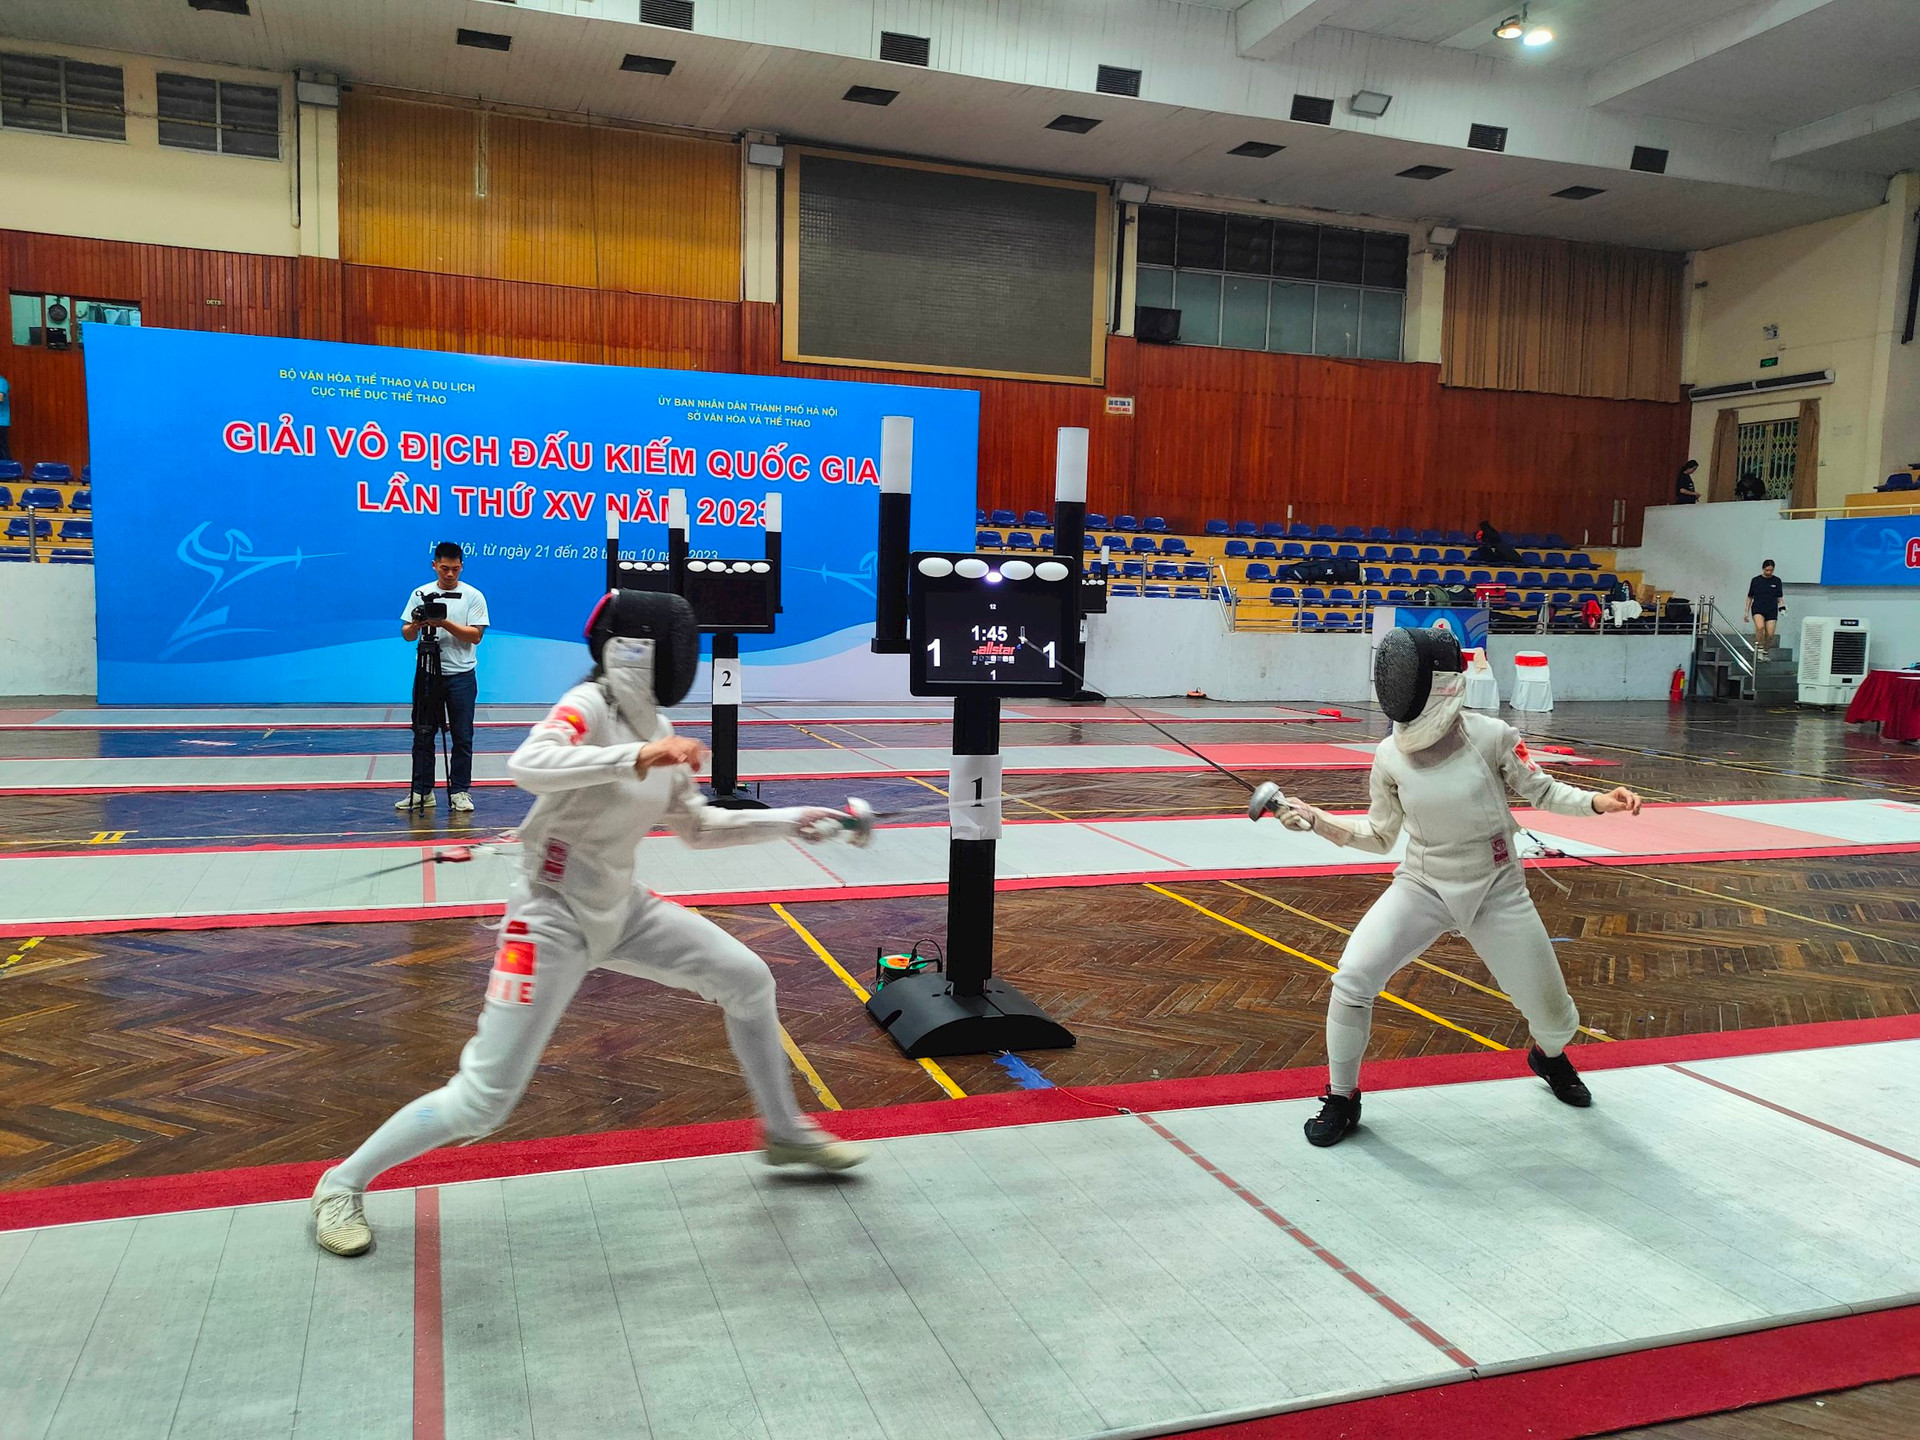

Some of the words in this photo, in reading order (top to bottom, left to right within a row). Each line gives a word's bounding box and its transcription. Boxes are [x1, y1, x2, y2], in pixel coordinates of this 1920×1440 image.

[279, 368, 297, 381] BỘ
[299, 369, 324, 382] VĂN
[327, 371, 351, 383] HÓA
[355, 372, 377, 385] THỂ
[380, 377, 412, 388] THAO
[414, 377, 429, 389] VÀ
[432, 380, 448, 390] DU
[451, 382, 475, 394] LỊCH
[311, 386, 336, 397] CỤC
[339, 385, 361, 398] THỂ
[364, 389, 388, 401] DỤC
[391, 389, 413, 402] THỂ
[416, 393, 447, 405] THAO
[658, 395, 672, 406] ỦY
[674, 398, 695, 408] BAN
[697, 398, 725, 409] NHÂN
[727, 399, 747, 411] DÂN
[749, 401, 782, 413] THÀNH
[784, 403, 804, 415] PHỐ
[806, 405, 820, 415] HÀ
[822, 406, 838, 419] NỘI
[687, 410, 701, 421] SỞ
[703, 411, 723, 422] VĂN
[726, 412, 746, 424] HÓA
[748, 414, 762, 425] VÀ
[764, 415, 782, 426] THỂ
[785, 417, 811, 428] THAO
[223, 413, 316, 456] GIẢI
[326, 421, 388, 460] VÔ
[399, 430, 499, 470] ĐỊCH
[510, 431, 593, 471] ĐẤU
[605, 436, 696, 476] KIẾM
[706, 442, 810, 480] QUỐC
[819, 455, 880, 486] GIA
[357, 472, 440, 515] LẦN
[451, 482, 536, 518] THỨ
[544, 491, 595, 521] XV
[460, 541, 478, 558] ội,
[483, 542, 497, 556] từ
[499, 544, 531, 560] ngày
[535, 544, 550, 558] 21
[554, 544, 579, 559] đến
[582, 546, 598, 559] 28
[601, 547, 636, 560] tng
[641, 548, 656, 561] 10
[688, 549, 719, 560] 2023
[1905, 537, 1920, 569] G
[971, 625, 1008, 642] 1:45
[927, 638, 941, 667] 1
[975, 641, 1015, 655] allstar
[1042, 640, 1056, 669] 1
[721, 670, 732, 687] 2
[990, 670, 997, 681] 1
[970, 776, 986, 808] 1
